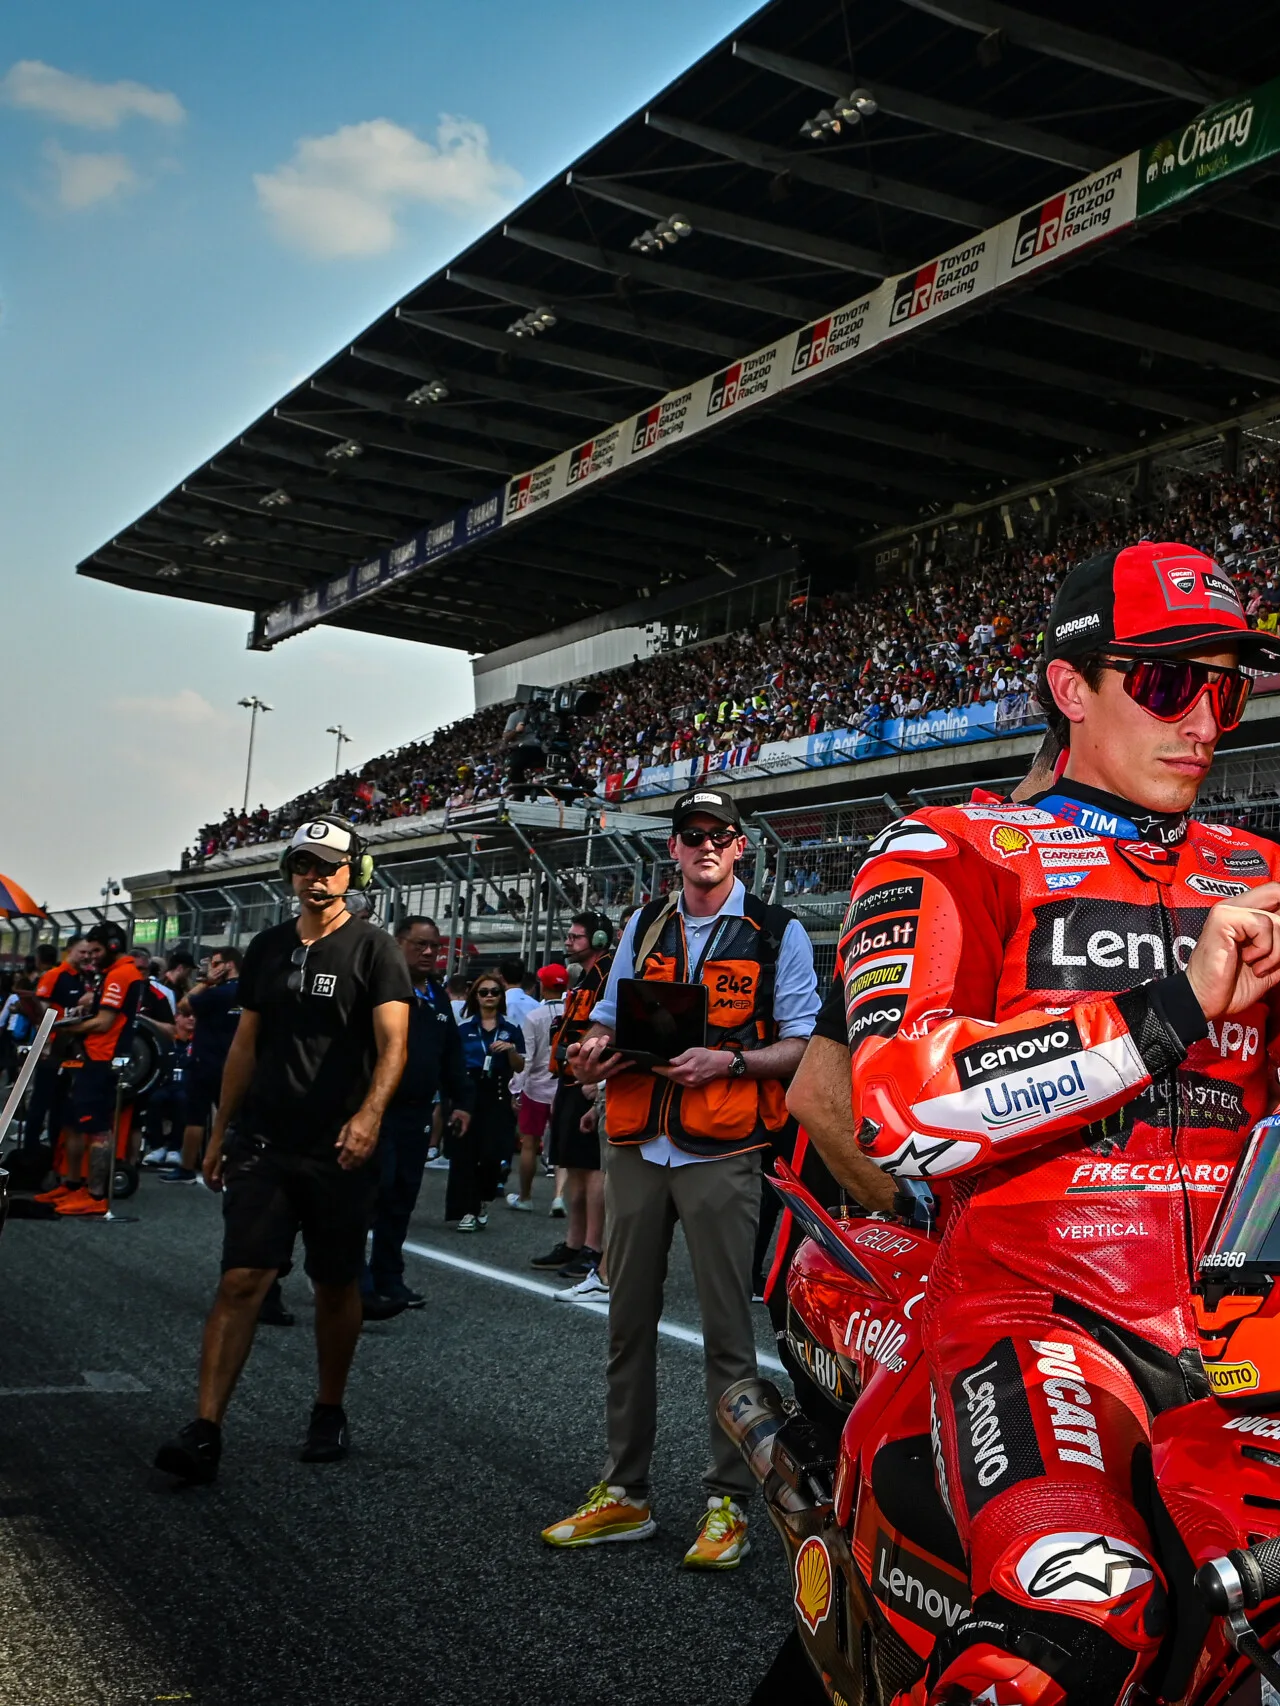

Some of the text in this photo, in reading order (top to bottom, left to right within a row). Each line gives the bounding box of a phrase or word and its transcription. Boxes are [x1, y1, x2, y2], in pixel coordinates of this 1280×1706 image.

[1177, 105, 1254, 166] Chang
[1069, 167, 1122, 205] TOYOTA
[1065, 189, 1114, 224] GAZOO
[1061, 207, 1111, 241] Racing
[1013, 217, 1061, 266] GR
[940, 241, 985, 272] TOYOTA
[936, 260, 979, 289] GAZOO
[891, 282, 932, 324] GR
[933, 278, 975, 305] Racing
[833, 301, 870, 328] TOYOTA
[829, 317, 864, 344] GAZOO
[792, 336, 828, 375] GR
[826, 333, 860, 359] Racing
[743, 348, 776, 373] TOYOTA
[740, 364, 771, 387] GAZOO
[661, 392, 692, 415] TOYOTA
[708, 381, 739, 415] GR
[658, 406, 688, 427] GAZOO
[1205, 575, 1237, 598] Lenovo
[1055, 613, 1100, 638] CARRERA
[1080, 809, 1118, 834] TIM
[1042, 850, 1107, 860] CARRERA
[1046, 875, 1083, 889] SAP
[859, 885, 914, 908] MONSTER
[1051, 917, 1198, 974] Leno
[317, 975, 332, 986] DA
[317, 985, 332, 996] ZN
[716, 975, 753, 994] 242
[964, 1031, 1070, 1077] Lenovo
[985, 1060, 1086, 1117] Unipol
[1071, 1162, 1234, 1184] FRECCIARO
[854, 1227, 919, 1257] GELLIFY
[1056, 1222, 1149, 1239] VERTICAL
[844, 1308, 909, 1365] riello
[887, 1352, 908, 1373] ups
[1028, 1340, 1105, 1473] DUCATI
[962, 1360, 1009, 1487] Lenovo
